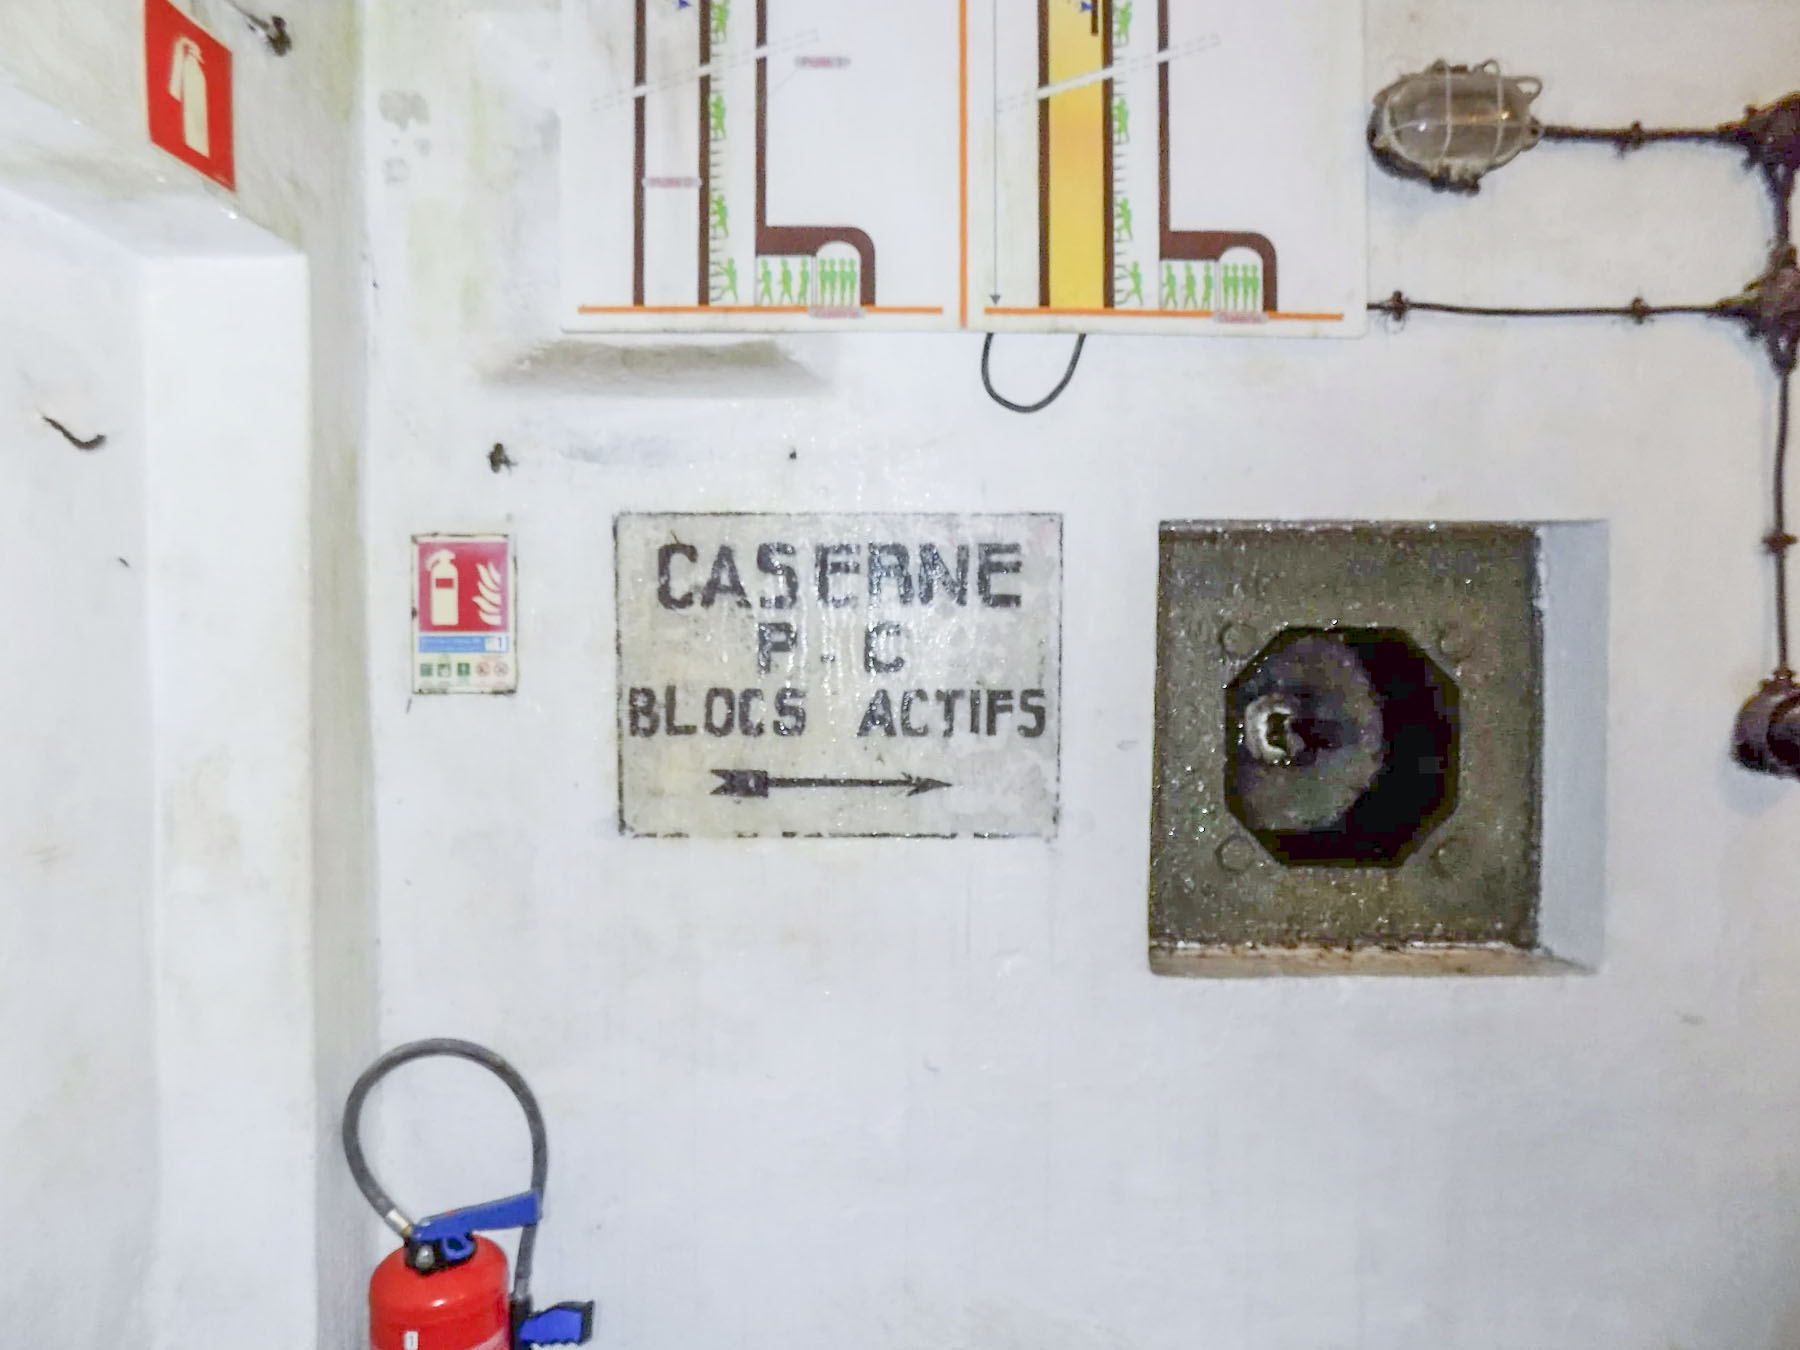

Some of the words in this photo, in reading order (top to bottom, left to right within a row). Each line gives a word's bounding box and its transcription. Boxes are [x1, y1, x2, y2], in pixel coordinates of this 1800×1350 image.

[657, 542, 1022, 610] CASERNE
[629, 686, 807, 738] BLOCS
[857, 688, 1047, 738] ACTIFS
